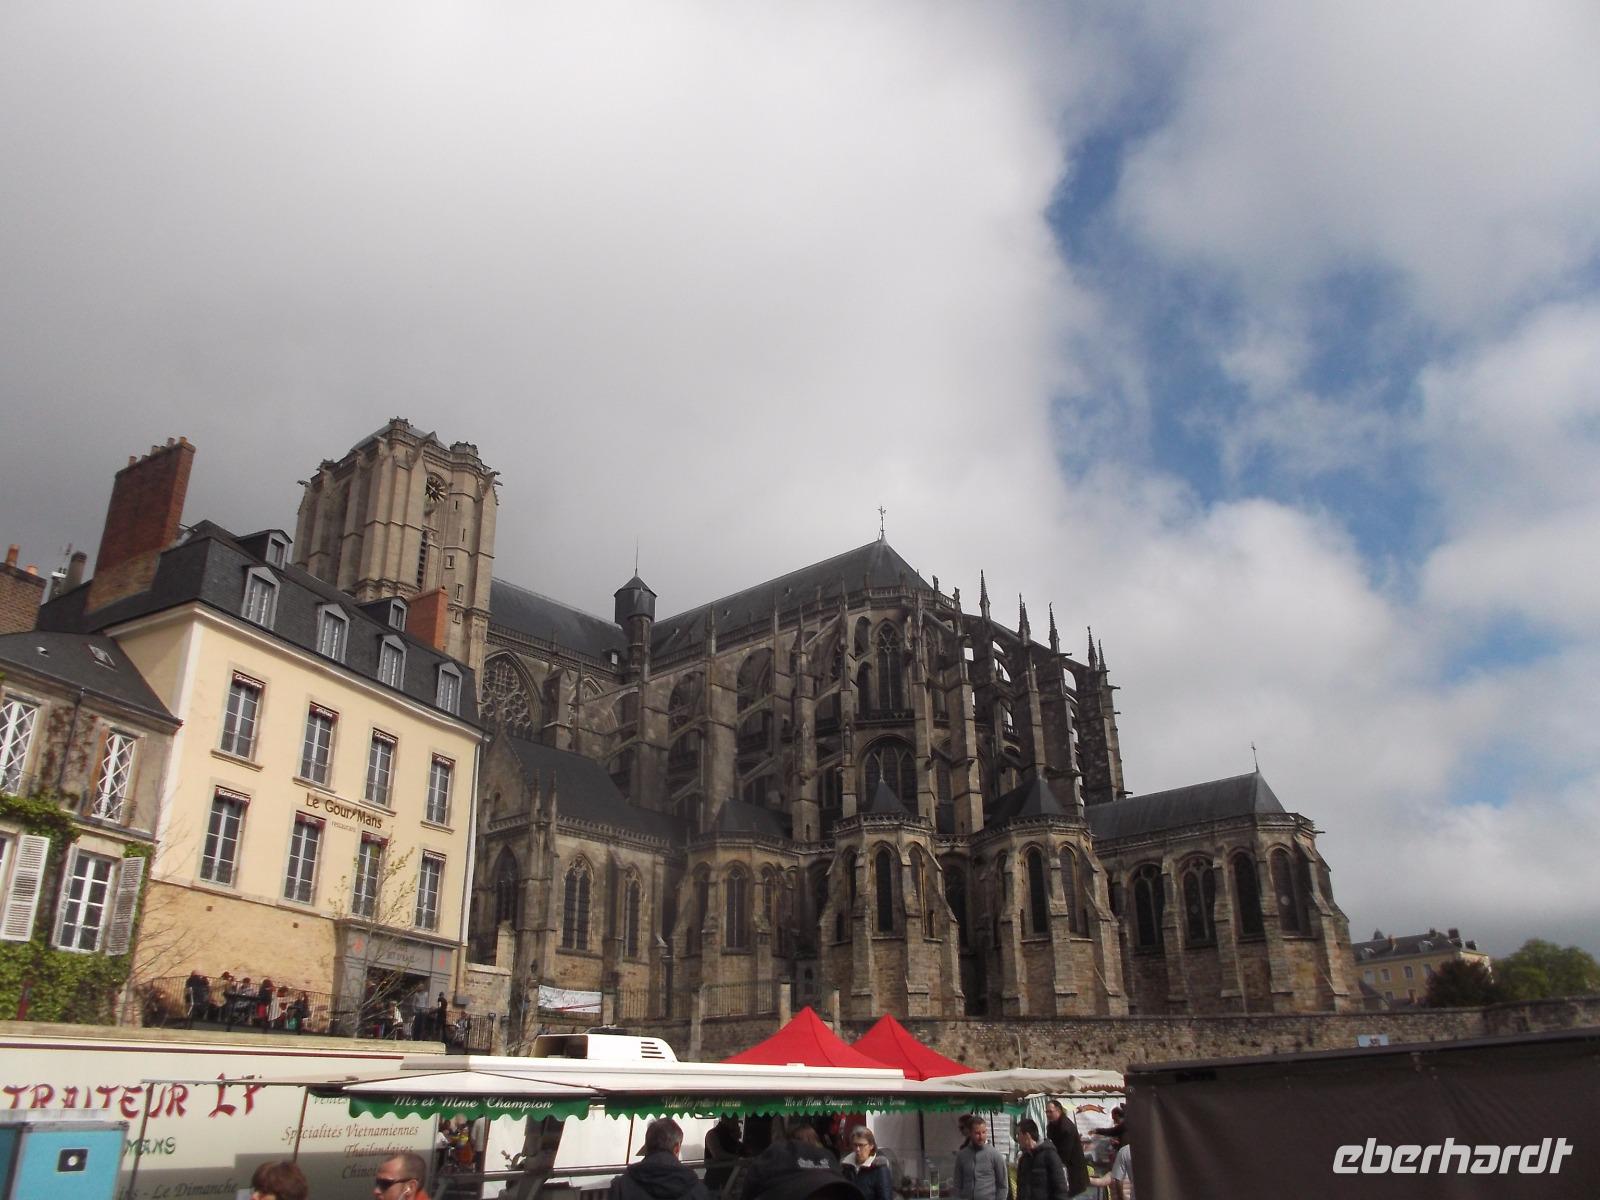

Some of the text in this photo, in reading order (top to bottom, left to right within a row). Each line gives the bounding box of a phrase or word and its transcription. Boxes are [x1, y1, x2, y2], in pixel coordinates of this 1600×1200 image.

[306, 792, 319, 809] Le
[2, 1083, 188, 1118] TRAITEUR
[421, 1097, 434, 1107] et
[440, 1096, 479, 1108] Mme
[482, 1096, 553, 1112] Champion
[281, 1123, 420, 1146] Spcialités Vietnamiennes
[152, 1184, 171, 1199] Le
[175, 1178, 239, 1196] Dimanche
